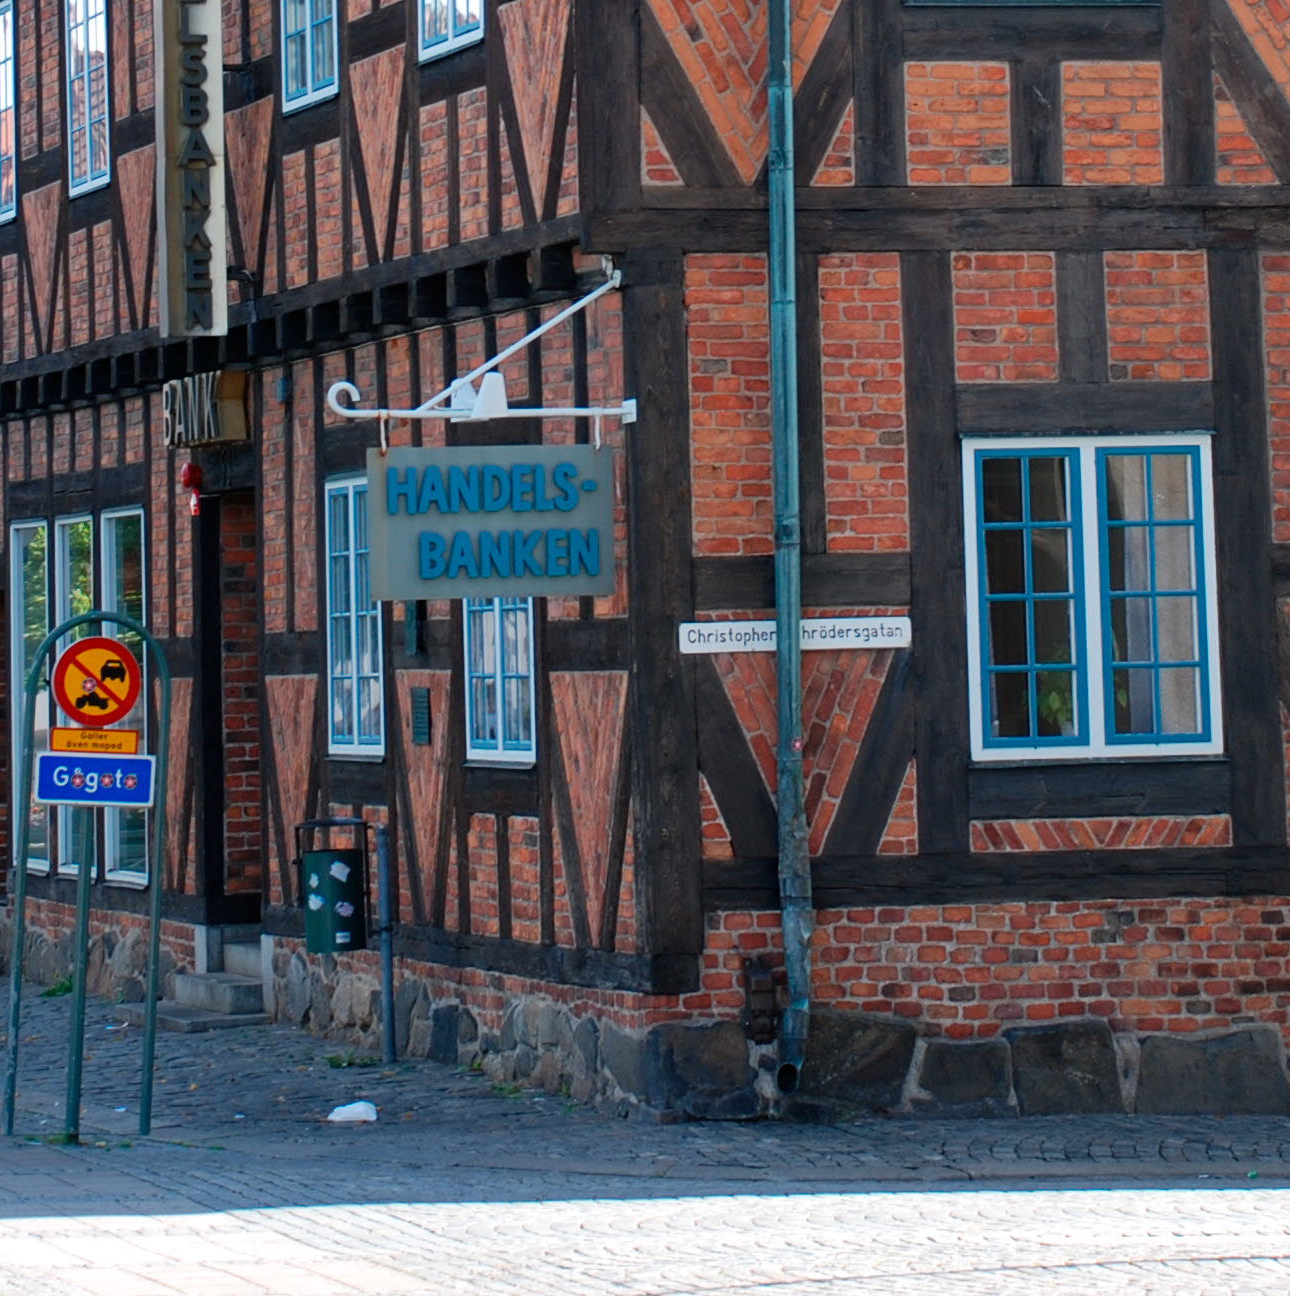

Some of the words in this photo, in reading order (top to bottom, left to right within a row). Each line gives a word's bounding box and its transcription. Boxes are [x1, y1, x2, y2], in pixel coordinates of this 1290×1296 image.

[163, 370, 221, 446] BANK
[386, 462, 599, 516] HANDELS-
[419, 528, 601, 581] BANKEN
[687, 625, 777, 648] Christopher
[800, 624, 904, 642] hrödersgatan
[91, 741, 123, 750] moped
